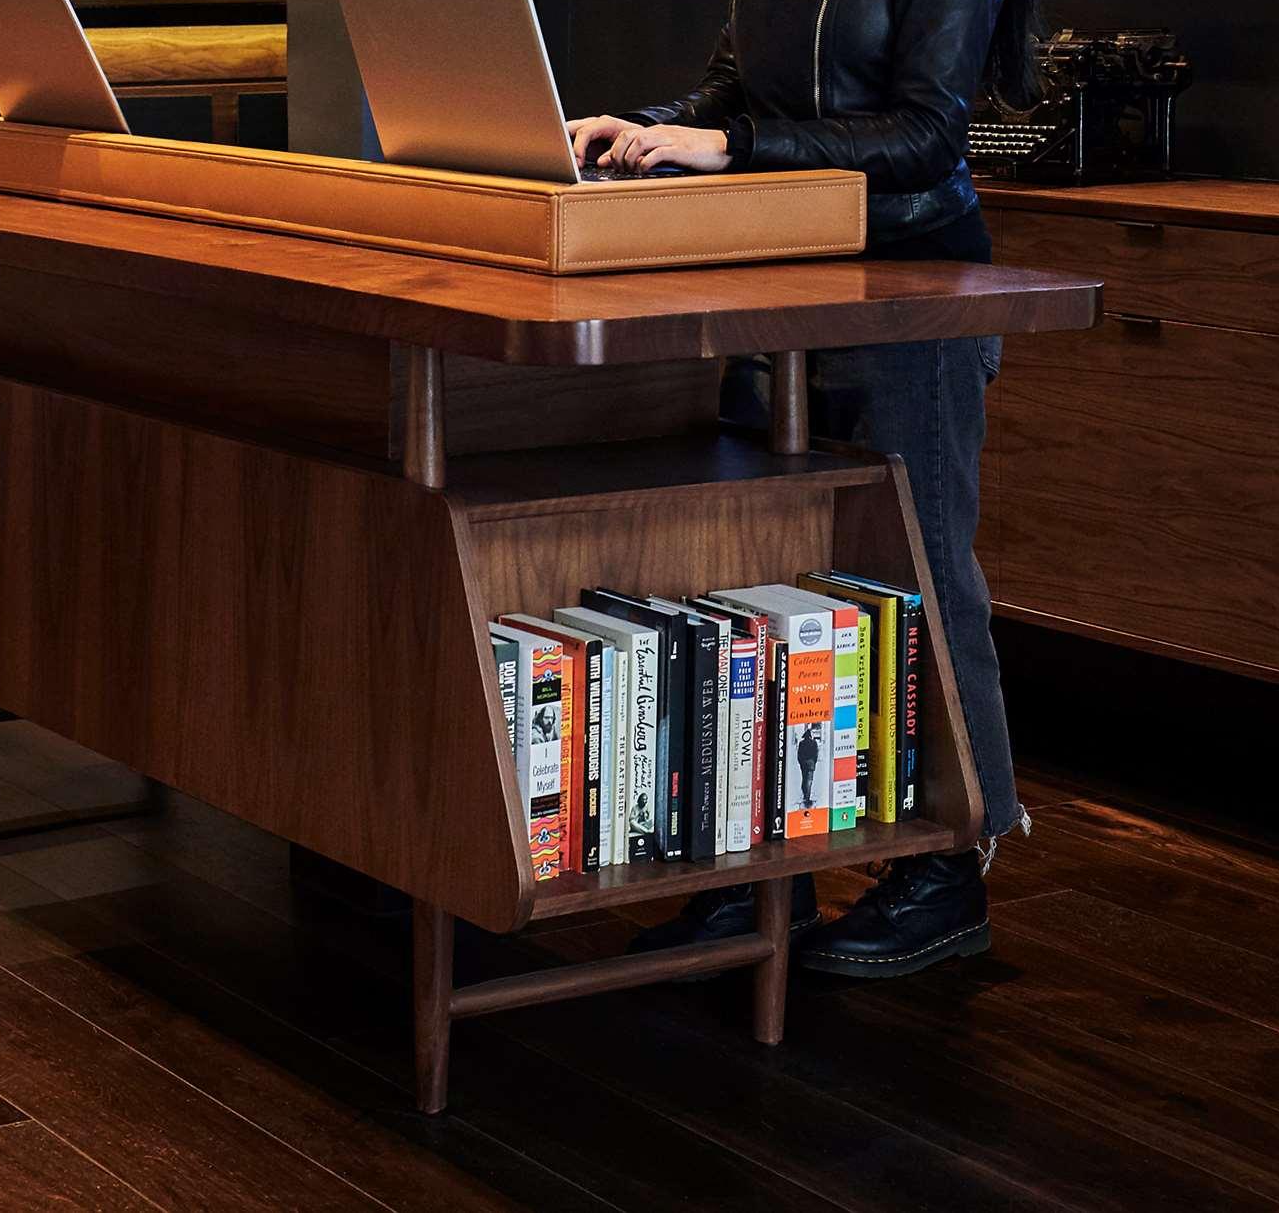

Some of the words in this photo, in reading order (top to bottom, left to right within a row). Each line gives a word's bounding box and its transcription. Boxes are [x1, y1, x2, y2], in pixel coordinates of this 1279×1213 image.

[758, 626, 766, 657] BANDS
[907, 626, 918, 665] NEAL
[503, 660, 517, 693] DON'T
[590, 654, 601, 679] WITH
[636, 647, 656, 692] Essential
[758, 658, 766, 672] ON
[793, 655, 830, 667] Collected
[798, 670, 823, 680] Poems
[589, 680, 601, 723] WILLIAM
[702, 679, 714, 708] WEB
[798, 695, 822, 705] Allen
[906, 673, 918, 736] CASSADY
[633, 695, 655, 752] Ginsberg
[778, 692, 786, 758] KEROUAC
[789, 709, 830, 721] Ginsberg
[588, 724, 600, 781] BURROUGHS
[701, 713, 714, 775] MEDUSA'S
[741, 719, 752, 766] HOWL
[532, 762, 560, 778] Celebrate
[536, 778, 556, 793] Myself
